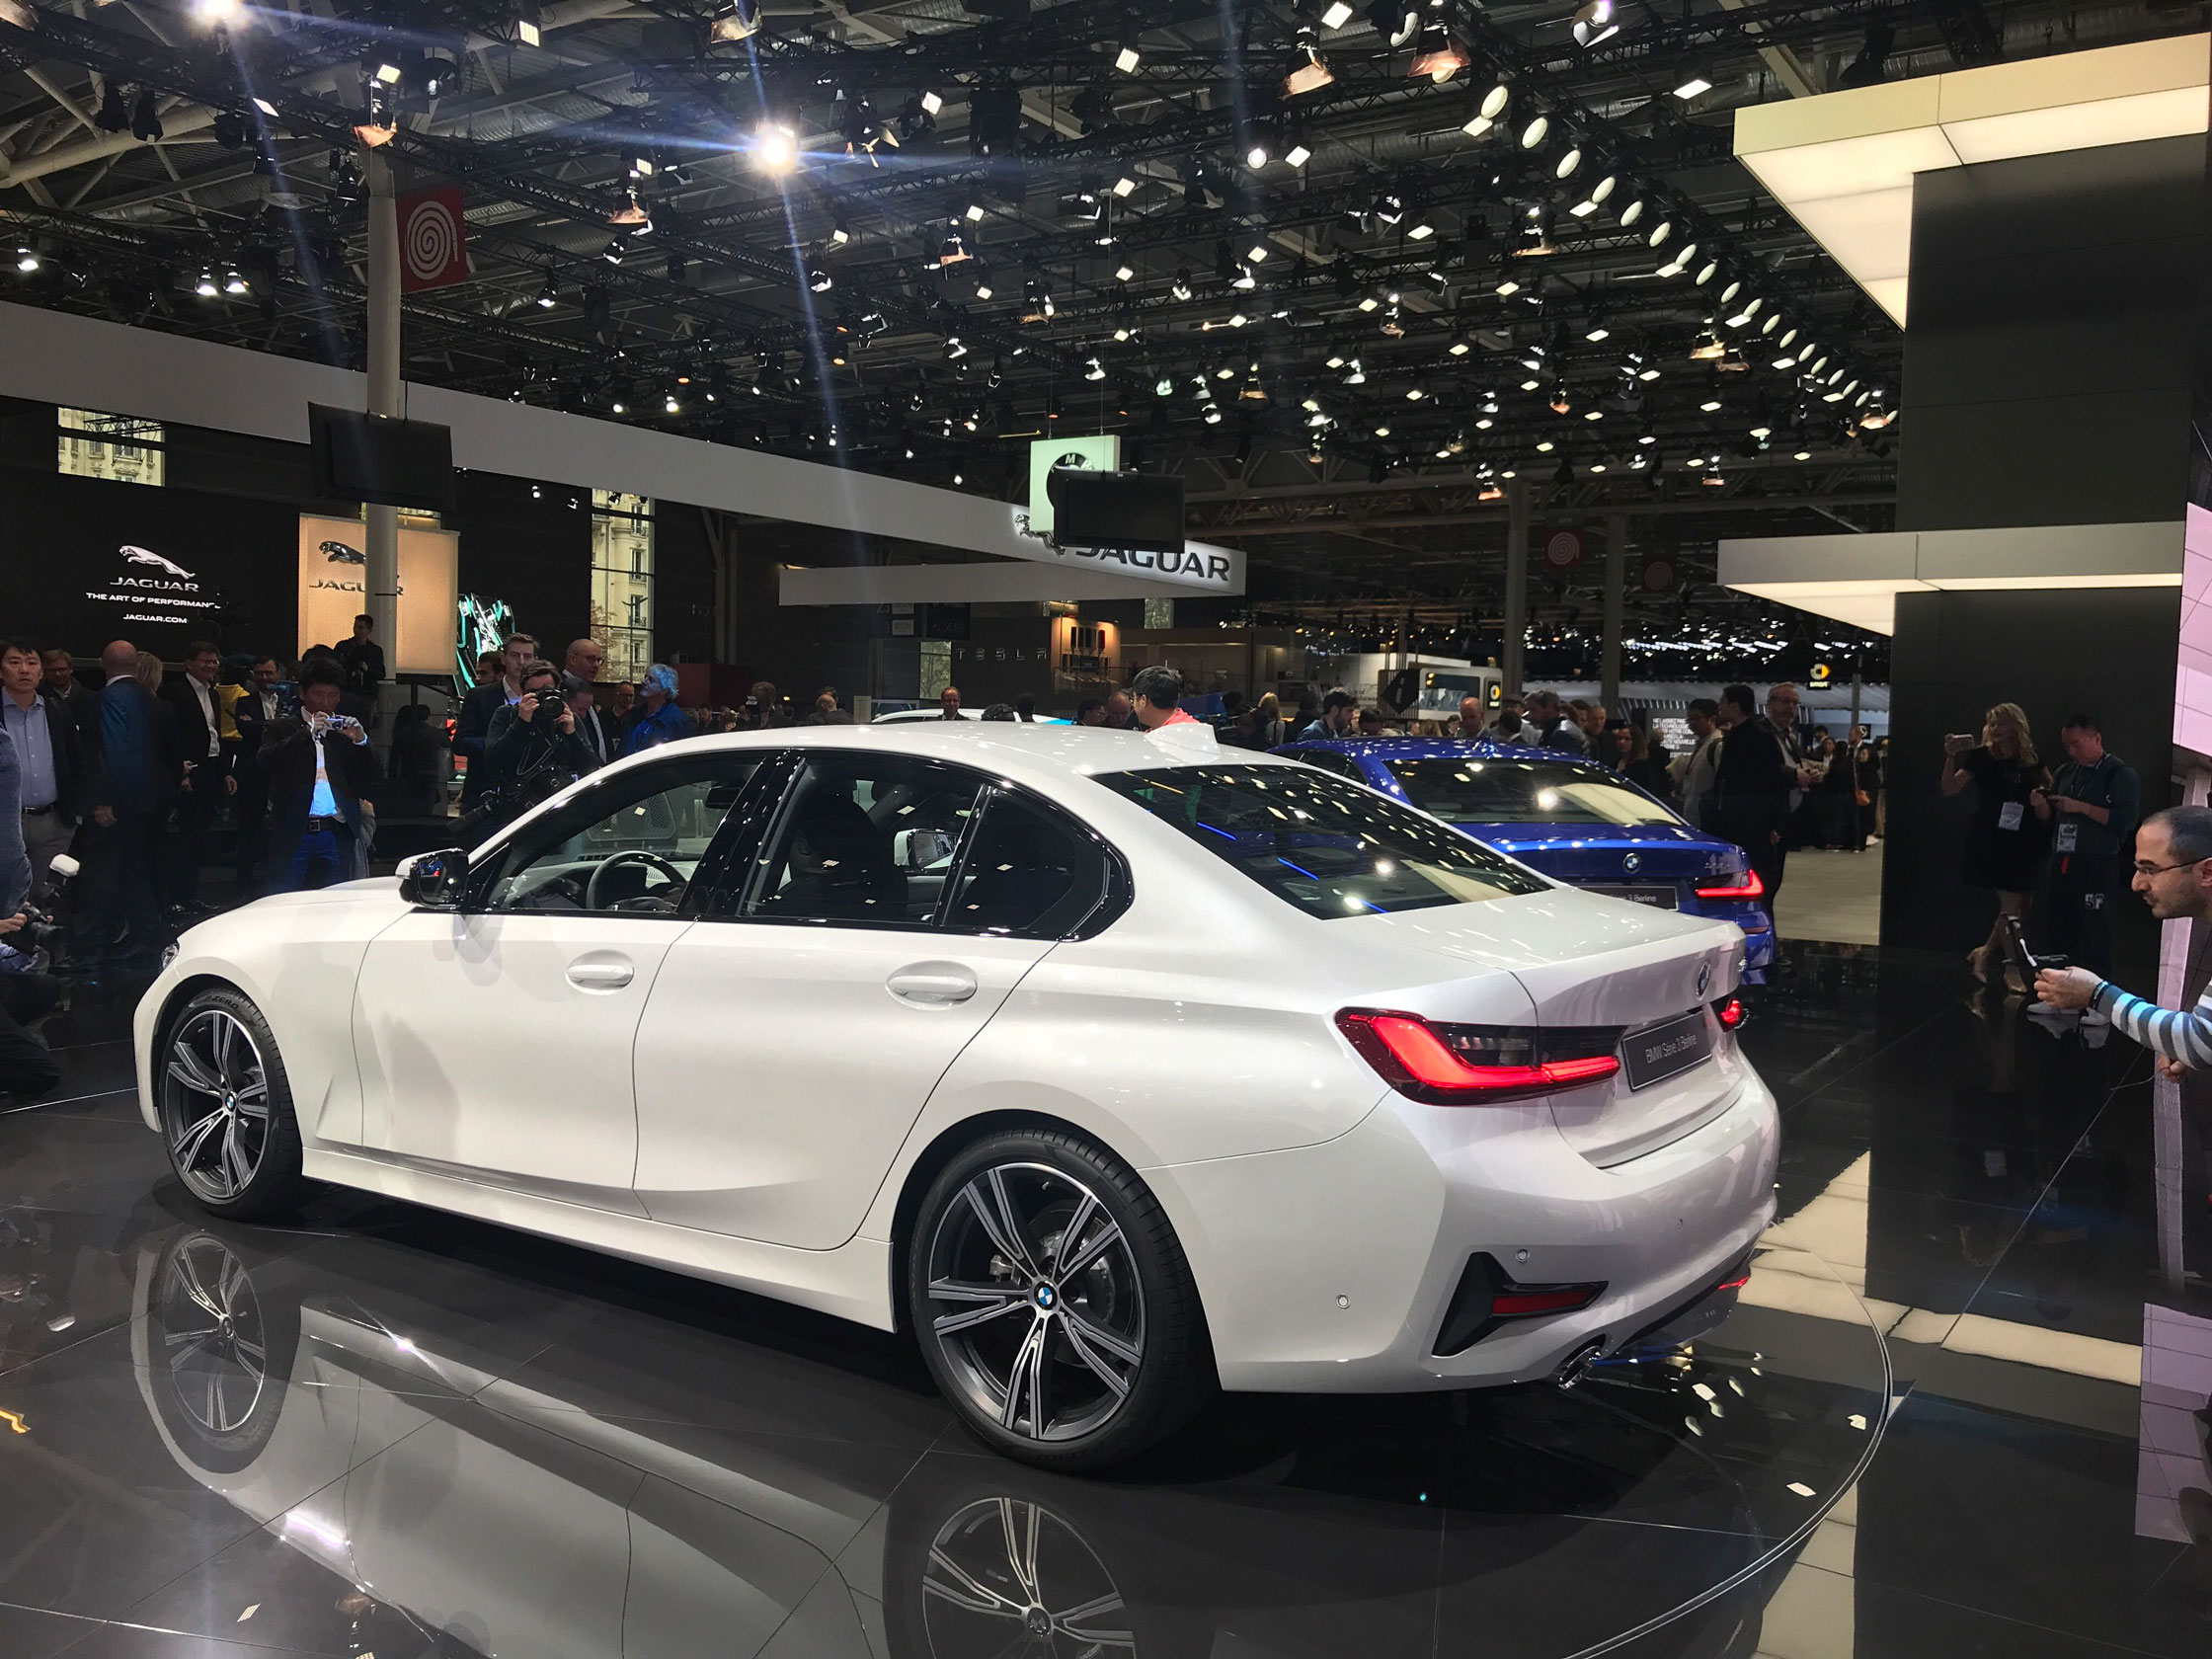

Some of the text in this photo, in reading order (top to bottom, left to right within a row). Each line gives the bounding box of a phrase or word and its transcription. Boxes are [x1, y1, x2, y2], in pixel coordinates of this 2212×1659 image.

[110, 577, 199, 592] JAGUAR
[309, 579, 404, 595] JAGUR
[123, 613, 188, 624] JAGUAR.COM
[958, 648, 1047, 660] TESLA
[211, 995, 239, 1009] ZERO
[1645, 1045, 1663, 1064] BMW
[1680, 1033, 1698, 1050] Berline
